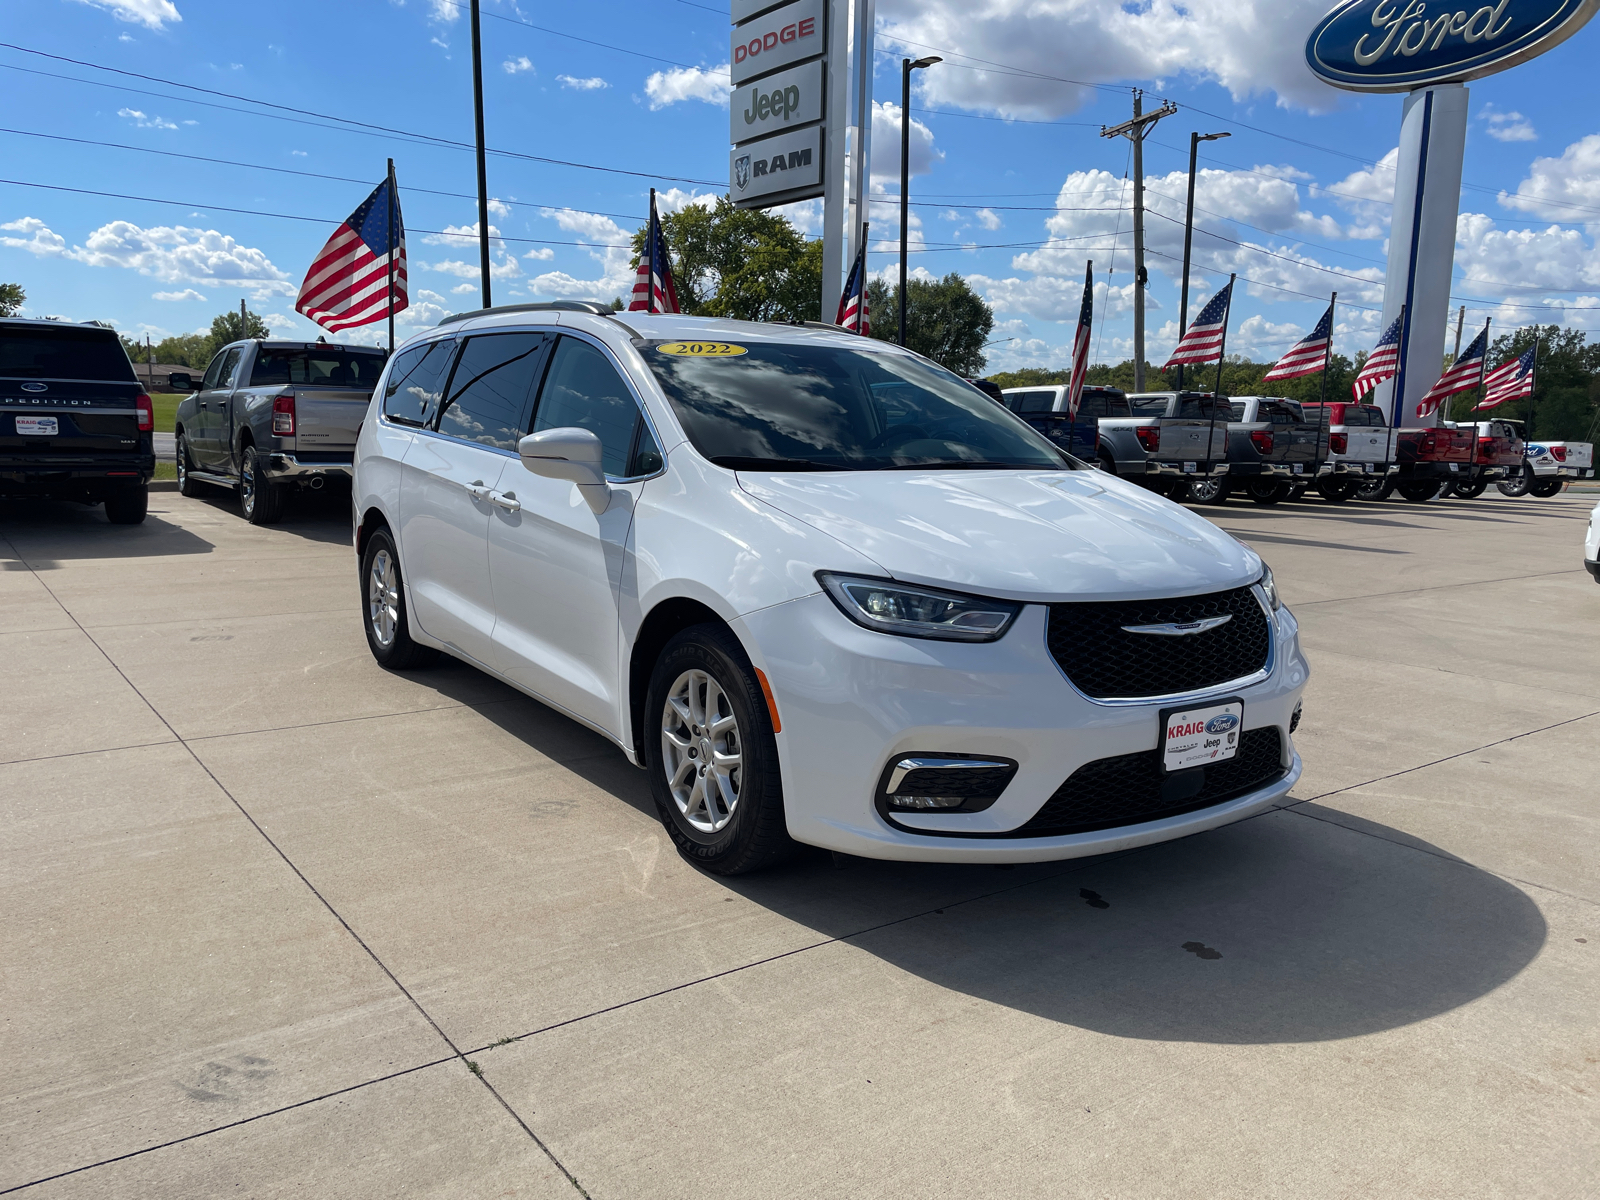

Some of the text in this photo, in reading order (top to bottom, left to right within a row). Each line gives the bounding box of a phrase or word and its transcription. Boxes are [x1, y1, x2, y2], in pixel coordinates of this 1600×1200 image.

[734, 17, 815, 64] DODGE
[1353, 0, 1512, 66] Ford
[744, 84, 800, 124] Jeep
[753, 148, 812, 178] RAM
[676, 344, 731, 353] 2022
[1168, 721, 1204, 739] KRAIG
[1204, 739, 1220, 748] Jeep
